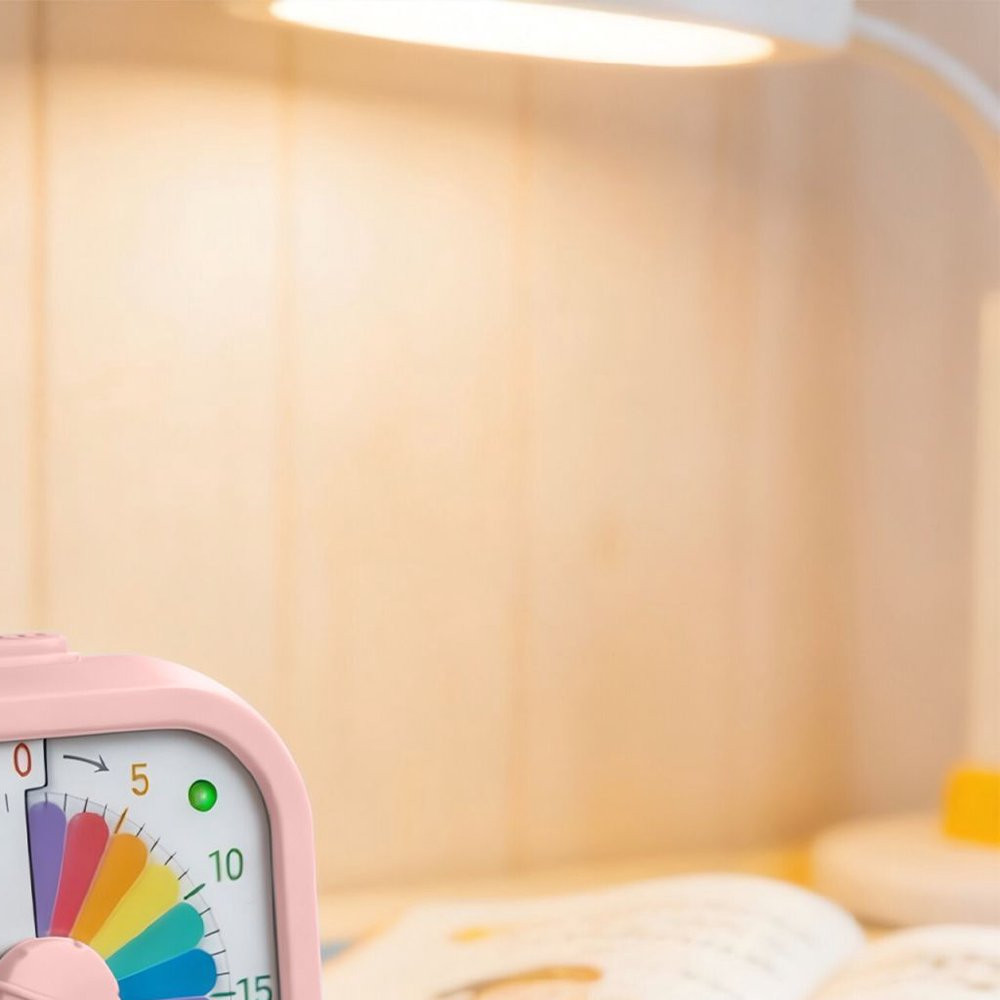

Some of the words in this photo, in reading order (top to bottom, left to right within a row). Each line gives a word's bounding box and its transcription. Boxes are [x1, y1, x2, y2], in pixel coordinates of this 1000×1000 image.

[13, 742, 32, 777] 0
[132, 763, 150, 796] 5
[208, 848, 244, 882] 10
